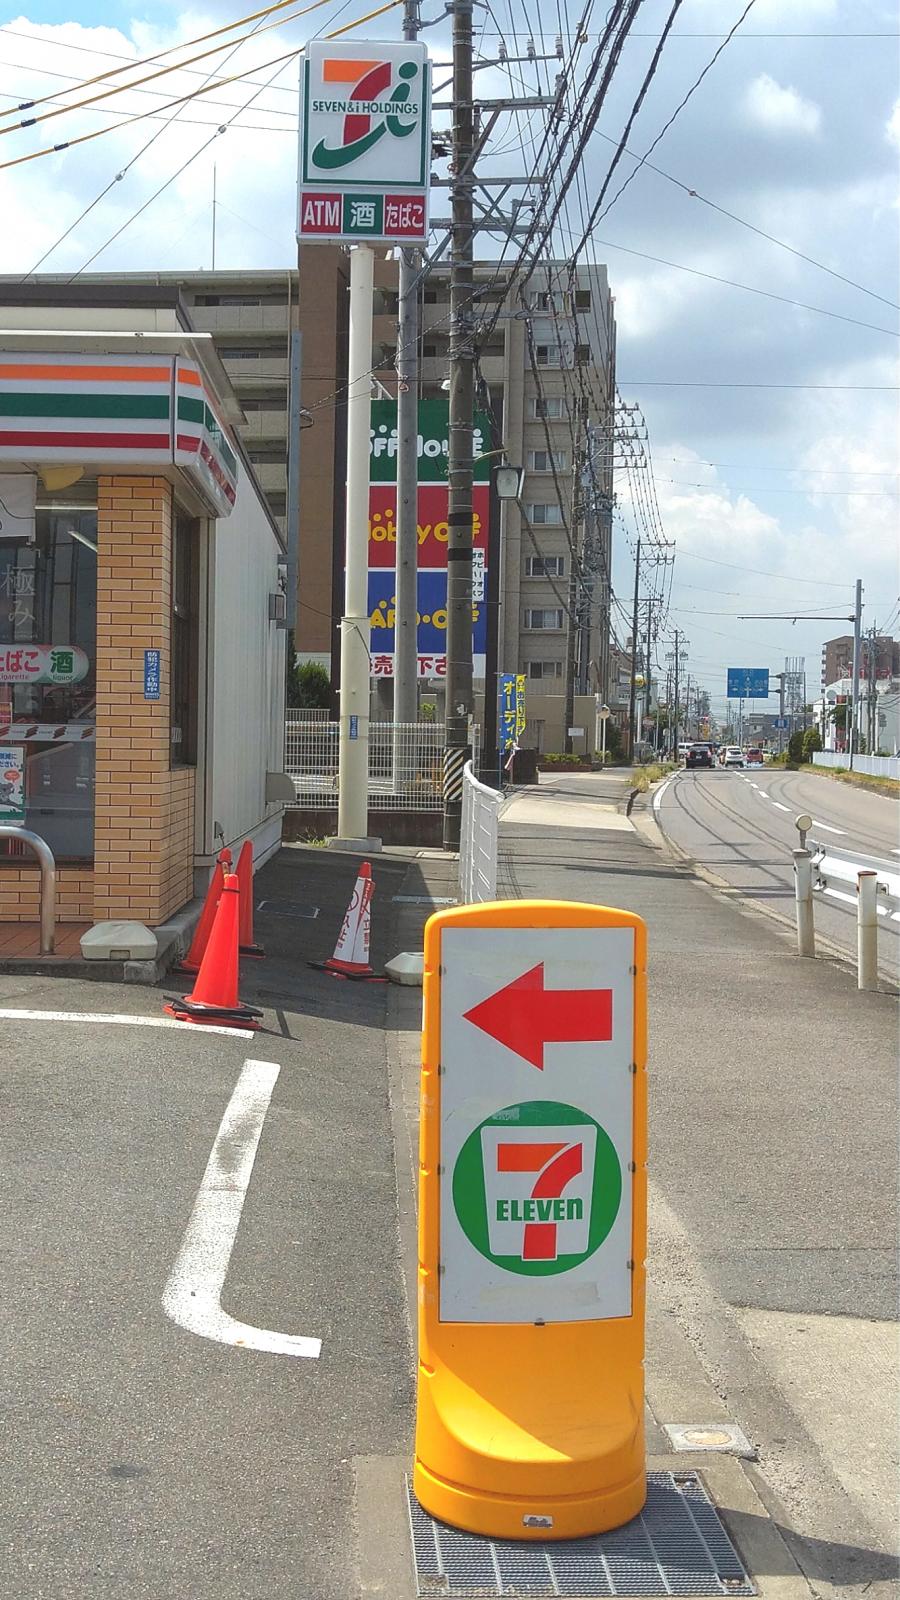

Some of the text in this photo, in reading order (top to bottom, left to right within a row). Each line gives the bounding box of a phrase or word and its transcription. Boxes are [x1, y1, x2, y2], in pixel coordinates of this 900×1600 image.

[362, 102, 418, 115] HOLDINGS
[303, 200, 340, 227] ATM
[350, 201, 376, 228] 酒
[386, 202, 424, 228] たばこ
[1, 564, 36, 626] 極み
[50, 650, 74, 674] 酒
[504, 681, 516, 750] オーディオ
